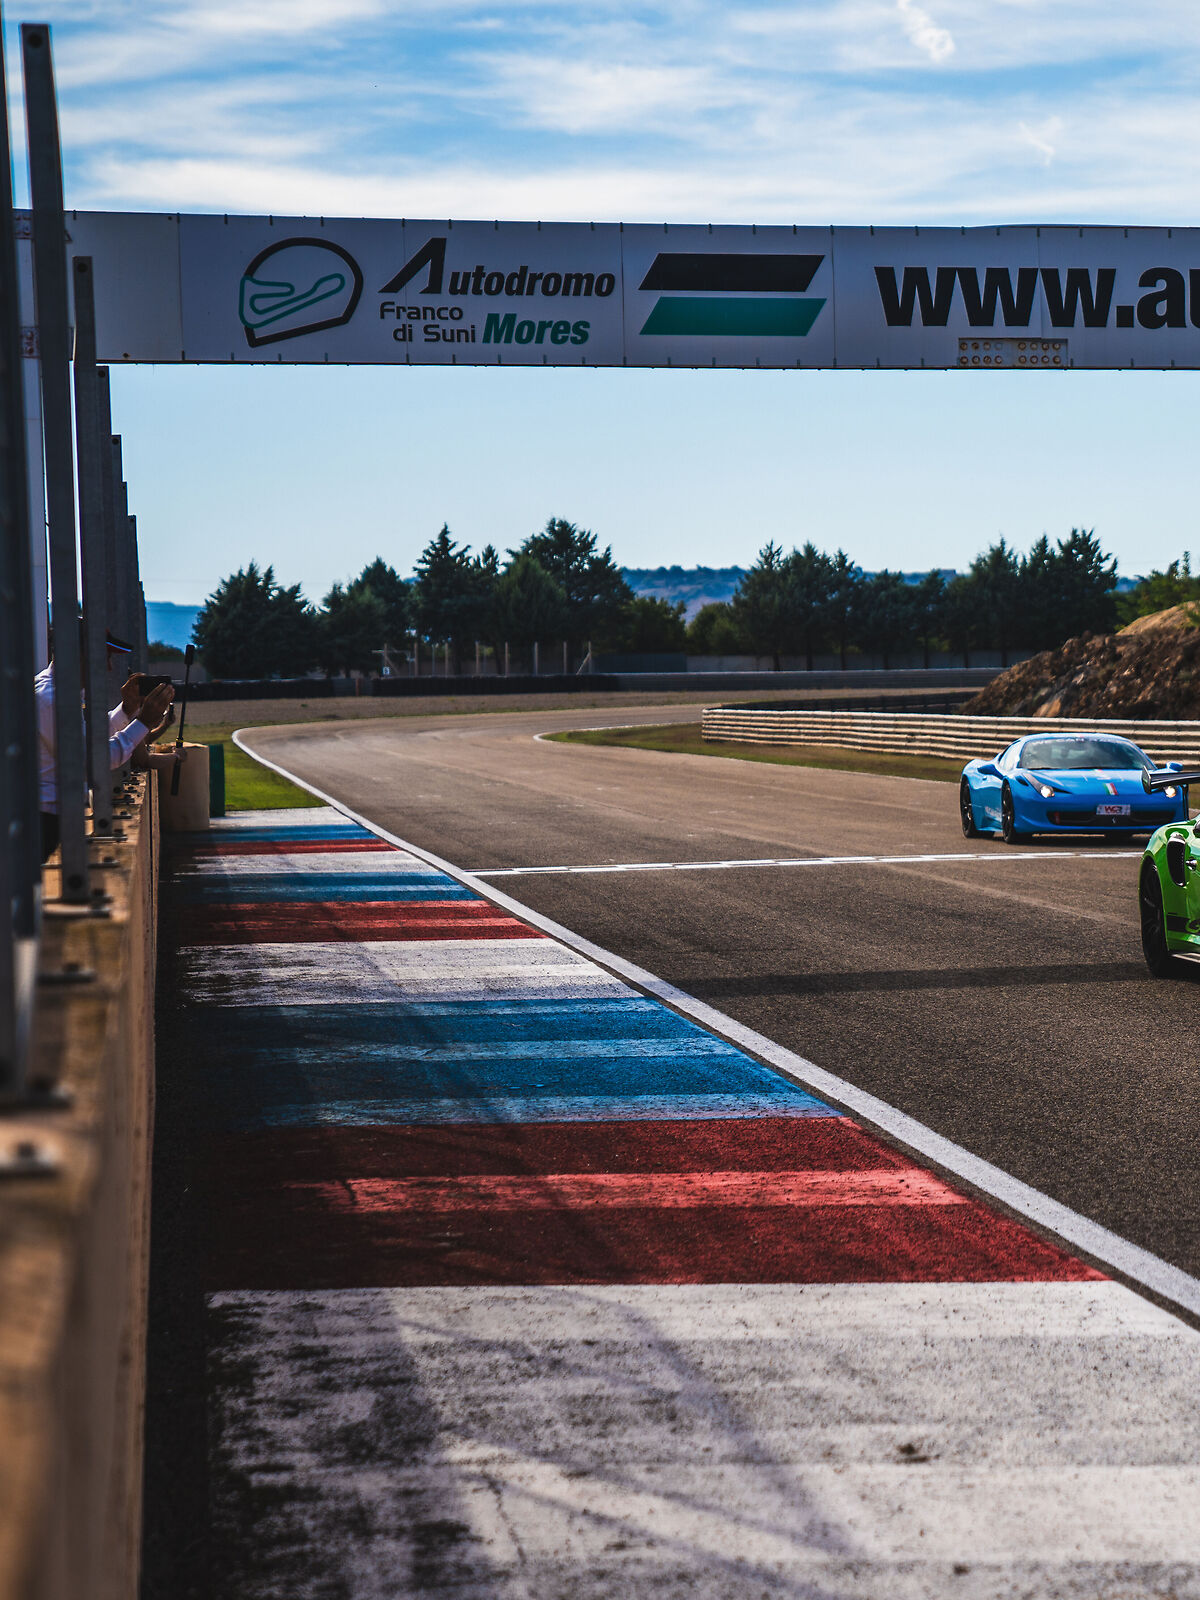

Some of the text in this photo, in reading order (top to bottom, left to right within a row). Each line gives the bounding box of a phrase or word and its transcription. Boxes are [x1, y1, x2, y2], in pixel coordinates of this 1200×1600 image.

[378, 237, 616, 297] Autodromo
[379, 301, 464, 321] Franco
[393, 324, 476, 343] di Suni
[482, 313, 591, 345] Mores
